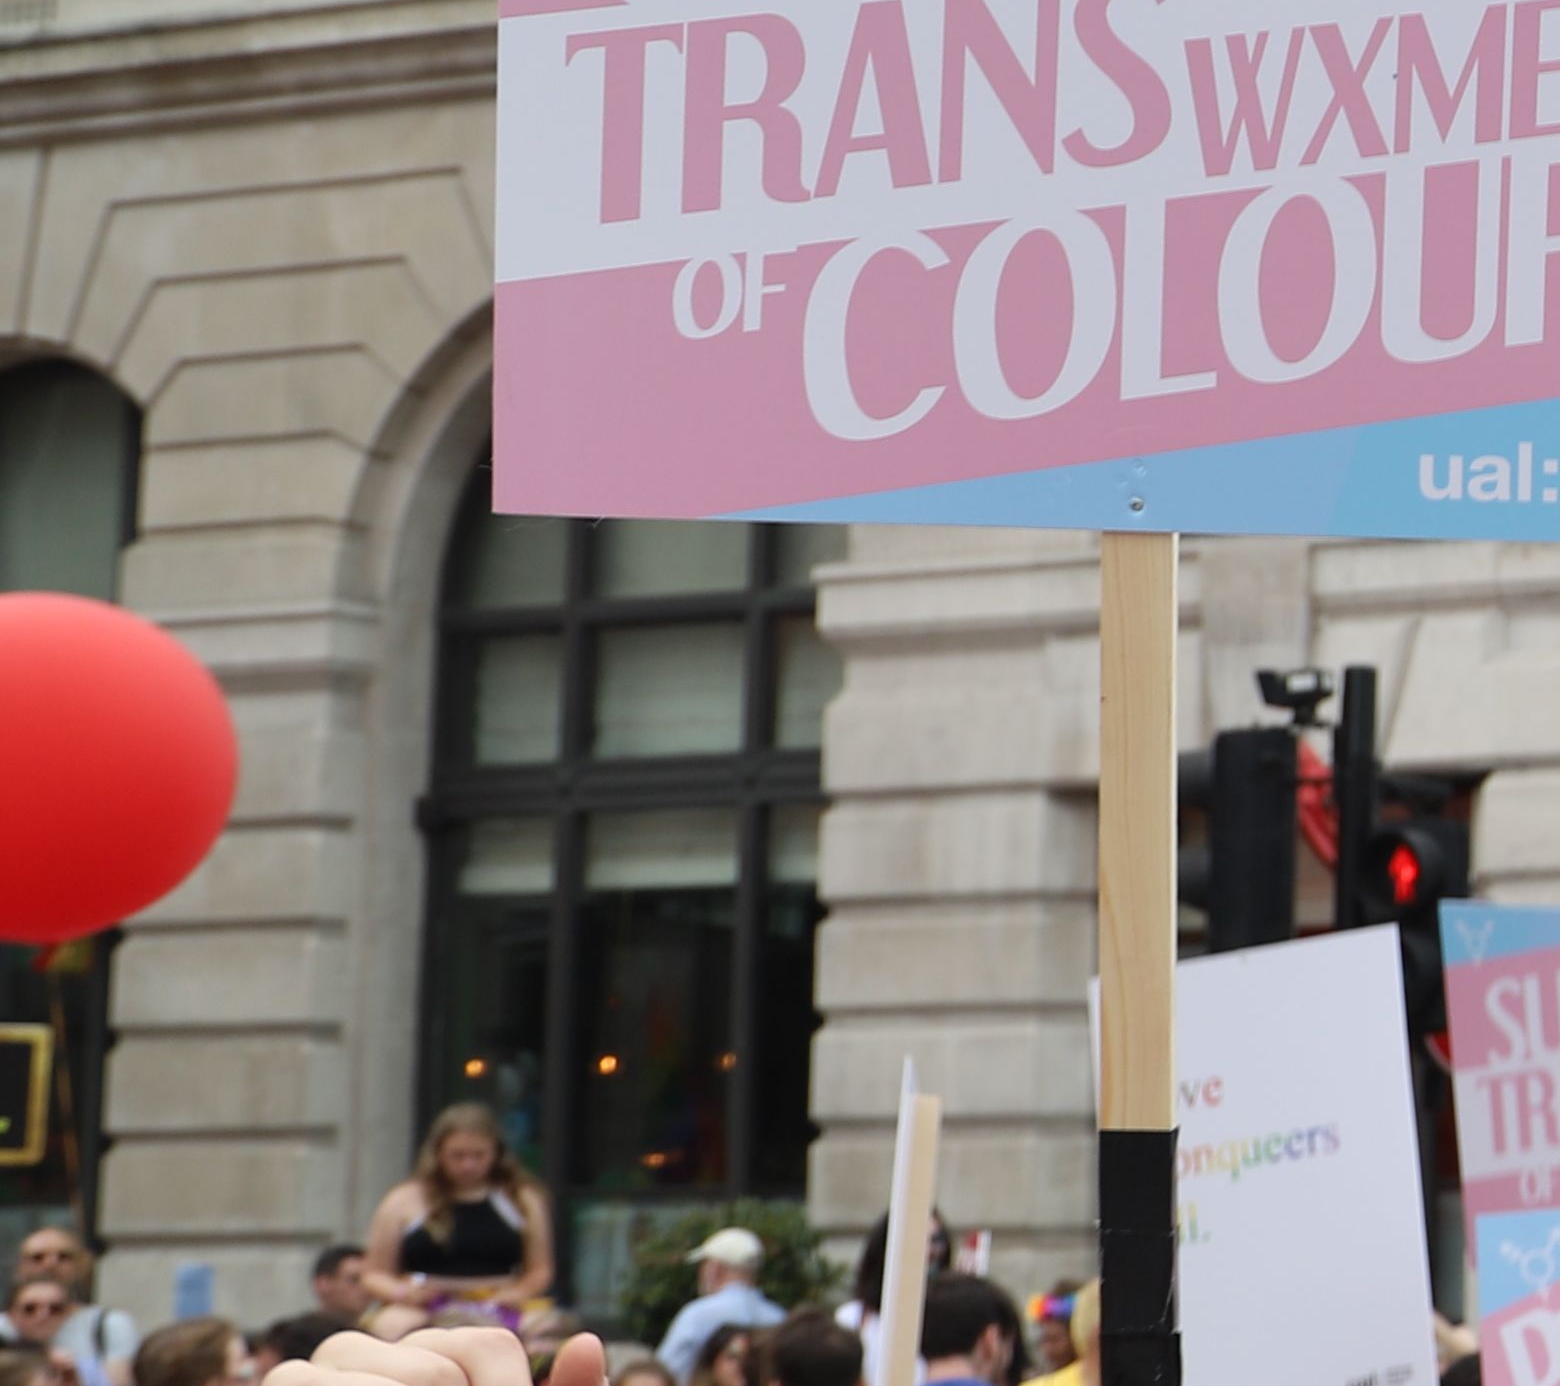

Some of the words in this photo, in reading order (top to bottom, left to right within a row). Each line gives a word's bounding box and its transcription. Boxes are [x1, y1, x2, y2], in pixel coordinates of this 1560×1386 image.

[672, 246, 798, 342] OF
[1418, 440, 1560, 503] ual:
[1179, 1075, 1224, 1111] ve
